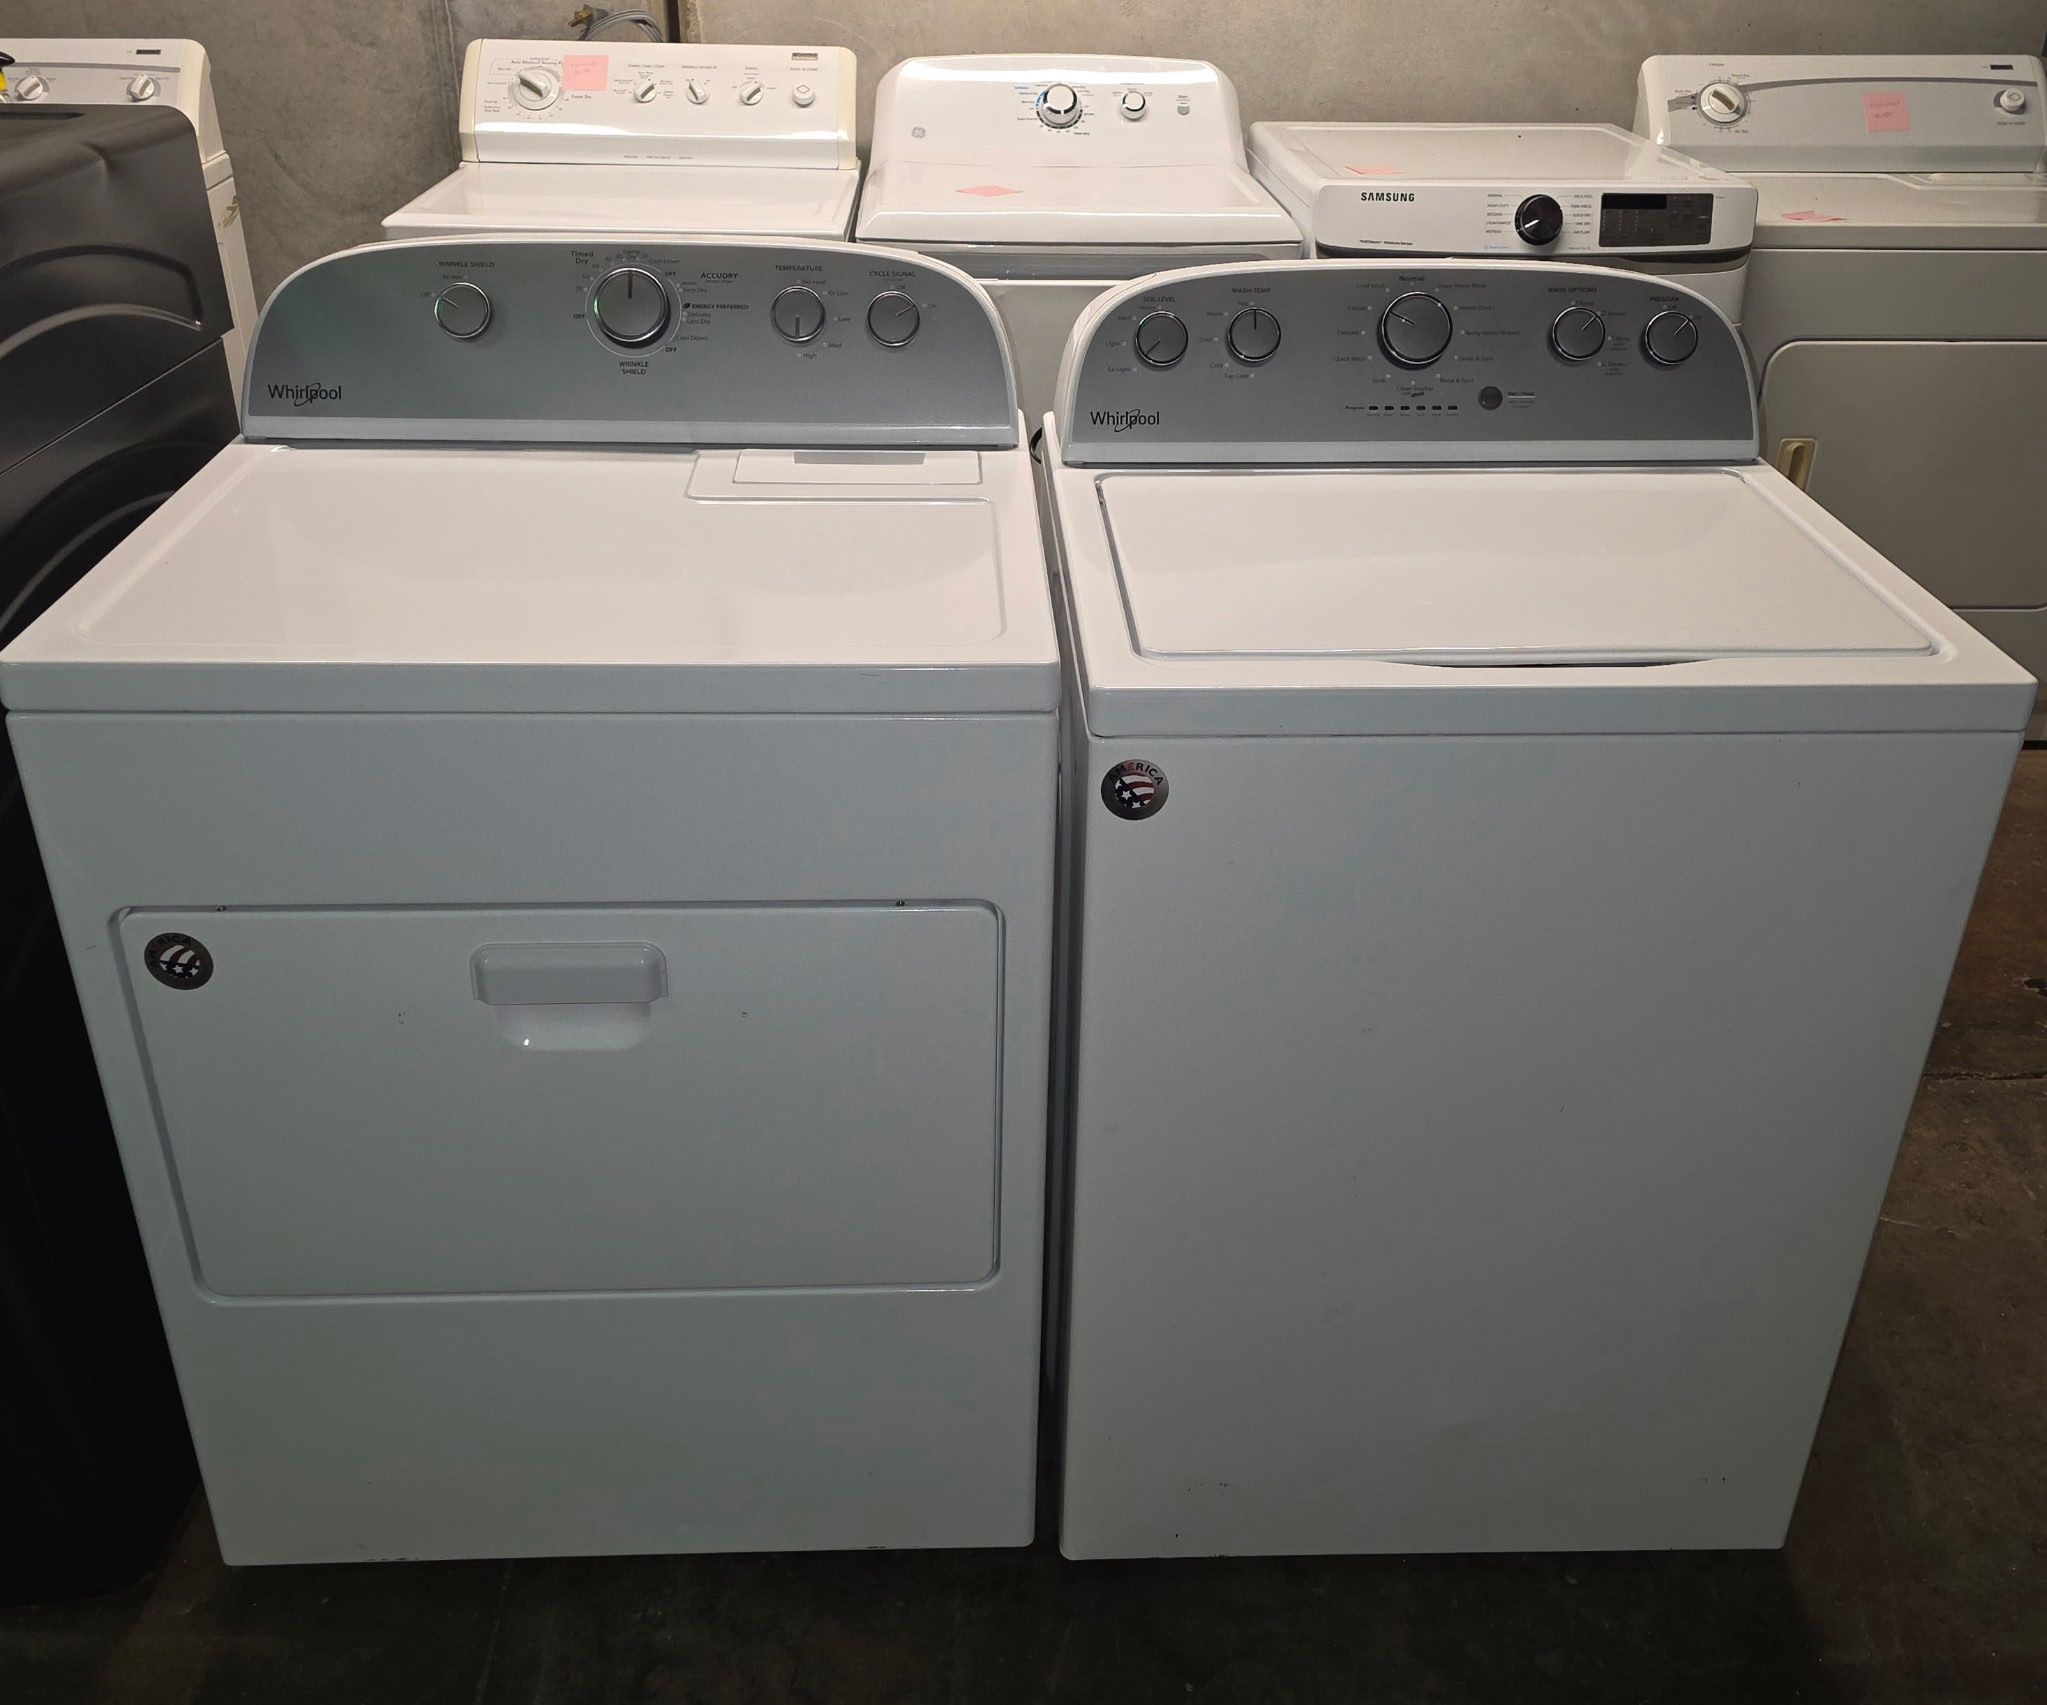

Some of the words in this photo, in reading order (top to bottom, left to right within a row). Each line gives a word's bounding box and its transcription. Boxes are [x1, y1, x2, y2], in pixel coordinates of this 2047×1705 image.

[1360, 192, 1415, 202] SAMSUNG
[571, 250, 594, 258] Timed
[438, 260, 469, 269] WRINKLE
[469, 260, 495, 269] SHIELD
[575, 257, 589, 265] Dry
[774, 264, 823, 272] TEMPERATURE
[700, 271, 739, 280] ACCUDRY
[869, 270, 890, 278] CYCLE
[890, 270, 916, 278] SIGNAL
[267, 382, 342, 407] Whirlpool
[1090, 408, 1160, 433] Whirlpool
